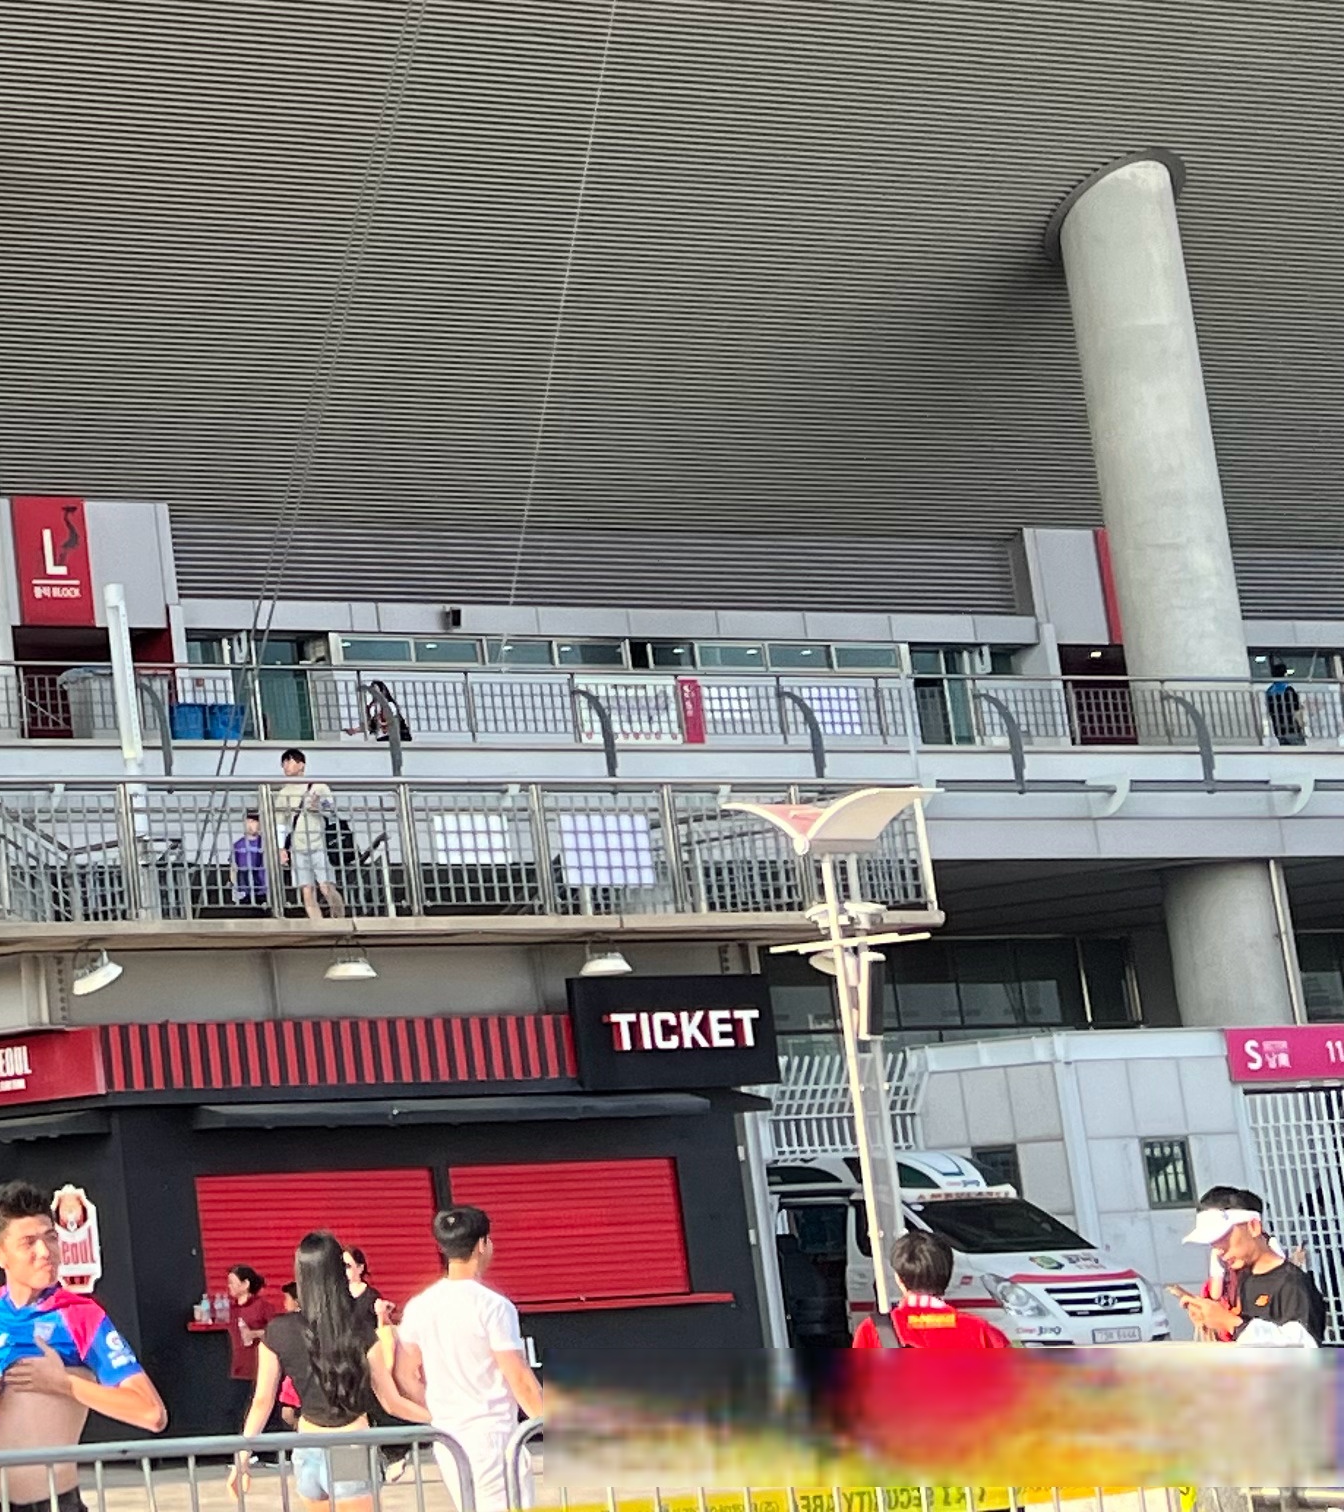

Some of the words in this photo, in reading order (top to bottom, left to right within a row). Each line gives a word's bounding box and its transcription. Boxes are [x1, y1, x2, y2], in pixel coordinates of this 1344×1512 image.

[42, 528, 68, 575] L
[608, 1009, 760, 1051] TICKET
[1244, 1039, 1263, 1071] S
[63, 1226, 96, 1265] eoul
